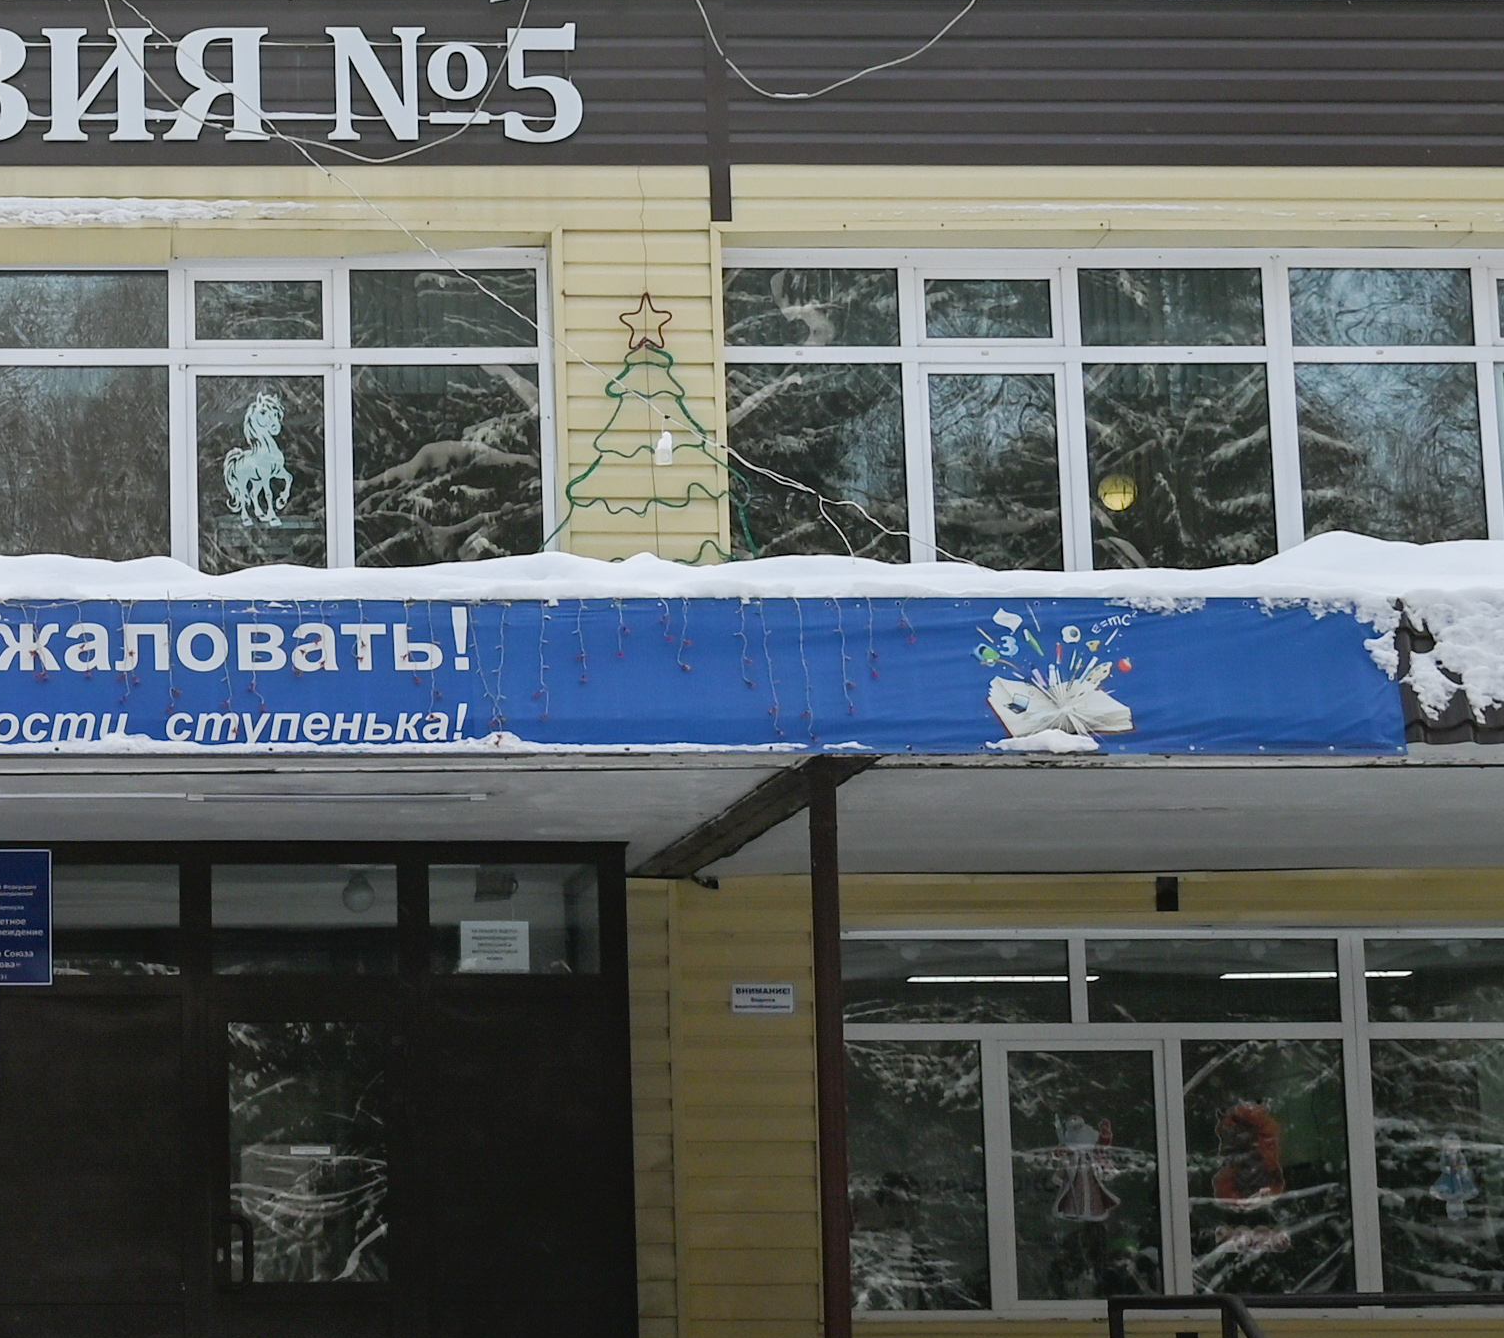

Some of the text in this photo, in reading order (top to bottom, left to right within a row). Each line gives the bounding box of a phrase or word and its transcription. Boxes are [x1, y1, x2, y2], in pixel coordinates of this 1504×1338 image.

[325, 23, 584, 145] №5
[162, 703, 468, 743] ступенька!
[3, 949, 34, 958] Союза
[735, 987, 791, 995] ВНИМАНИЕ!
